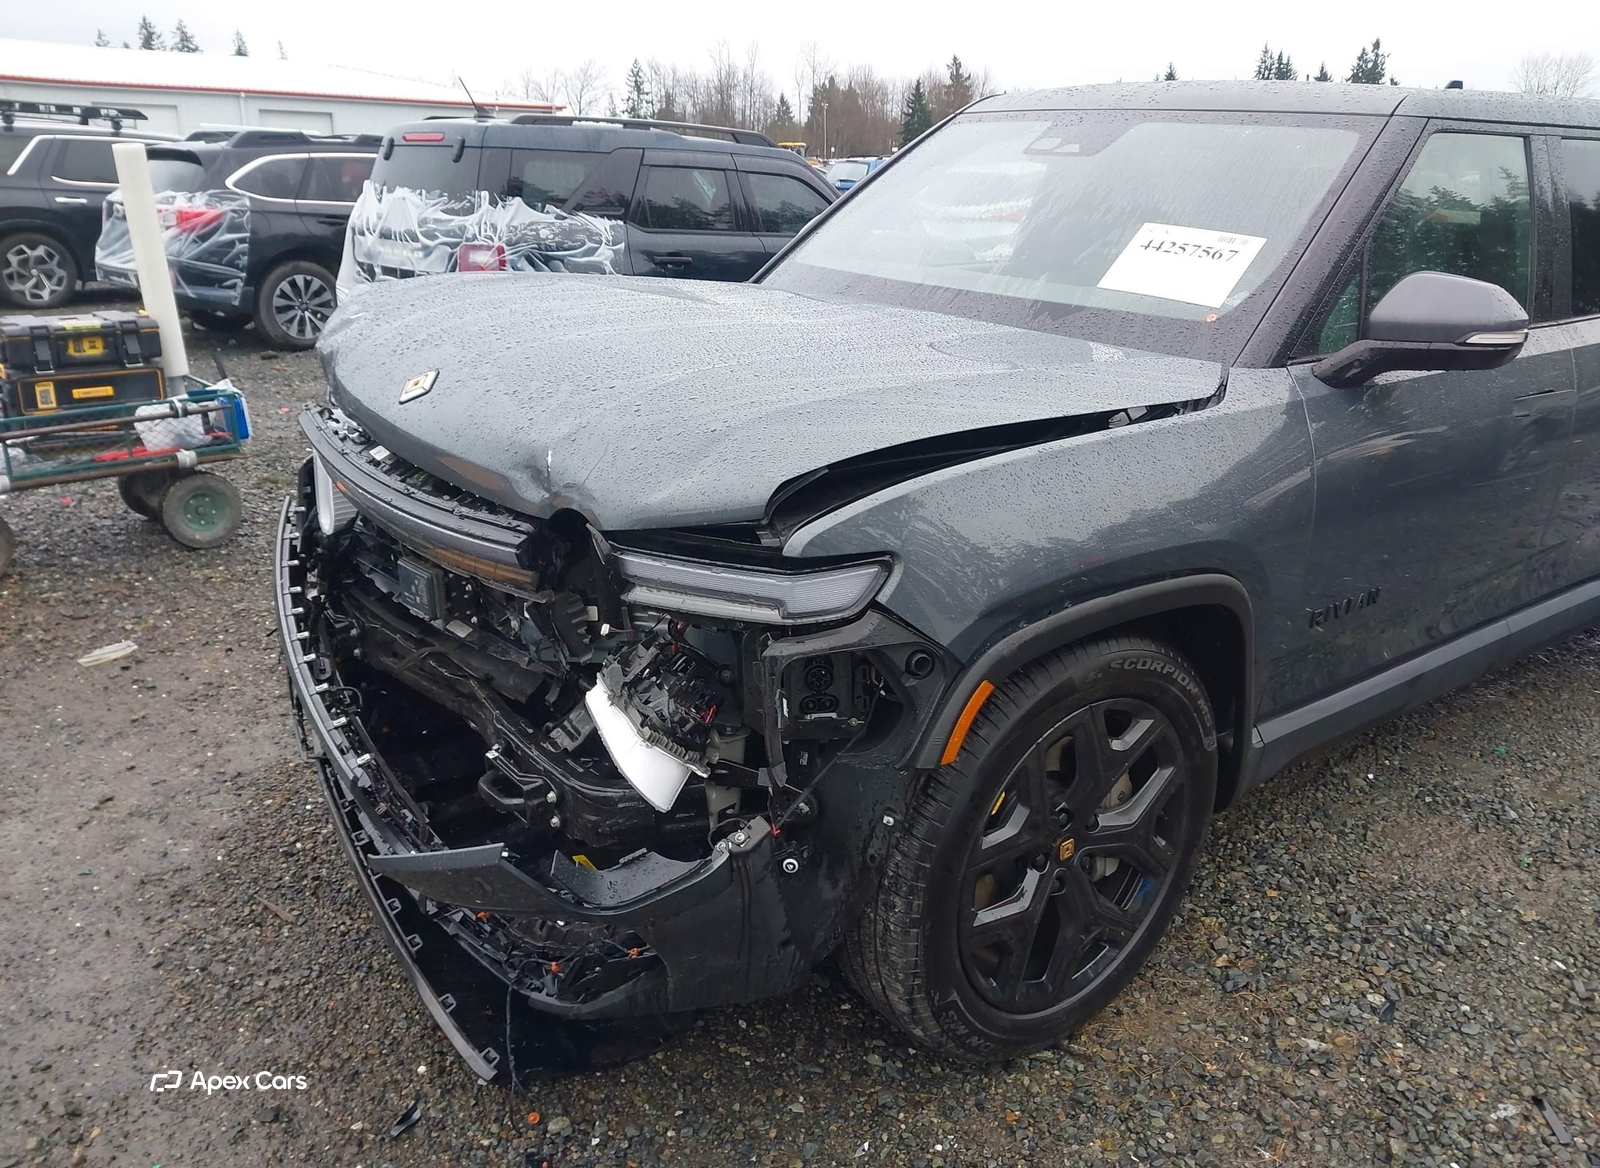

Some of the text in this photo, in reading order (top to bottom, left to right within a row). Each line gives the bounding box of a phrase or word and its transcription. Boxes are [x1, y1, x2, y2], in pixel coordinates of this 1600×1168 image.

[1140, 239, 1240, 262] 44257567
[1306, 587, 1381, 631] RIVIAN
[1110, 658, 1198, 694] SCORPION
